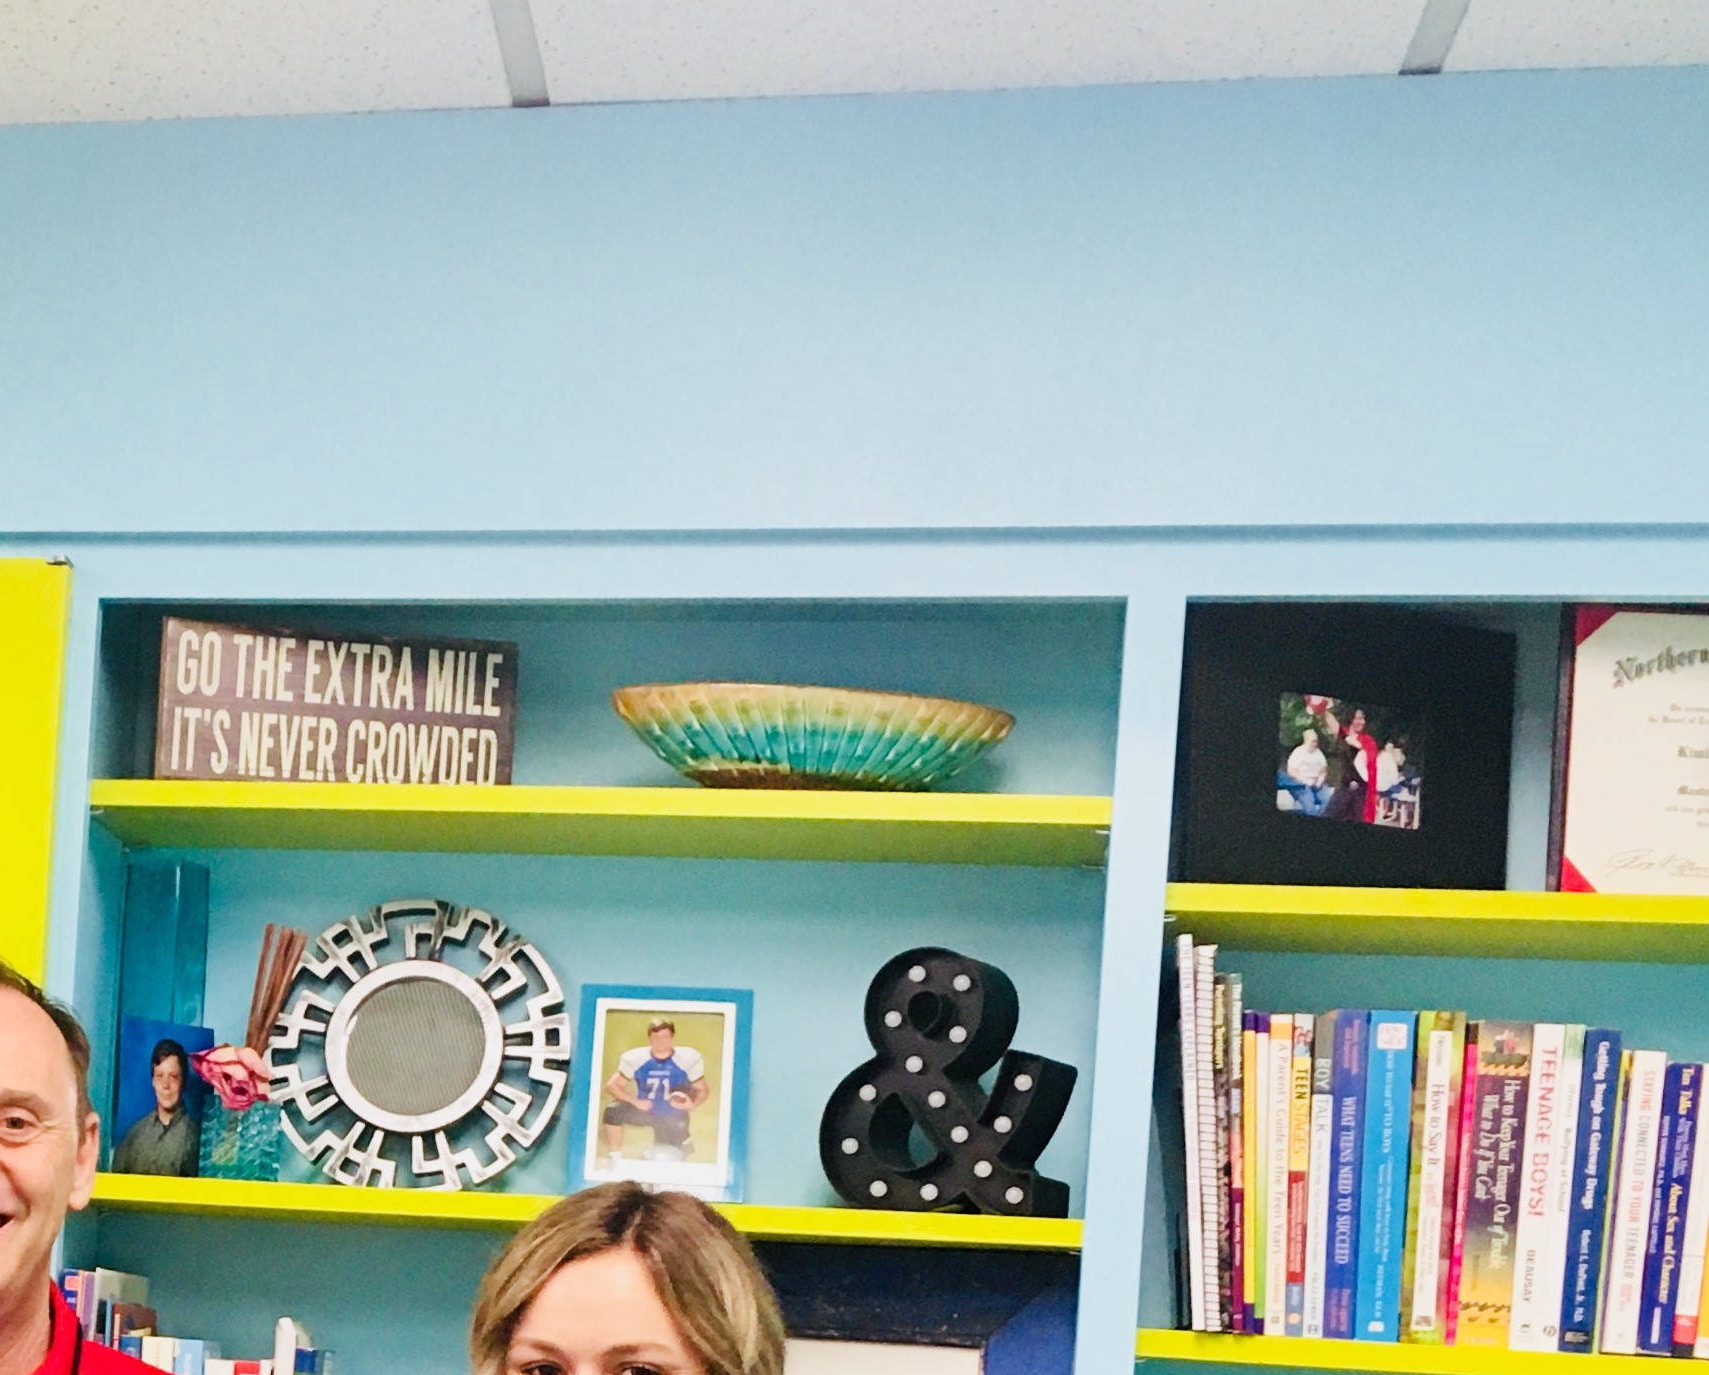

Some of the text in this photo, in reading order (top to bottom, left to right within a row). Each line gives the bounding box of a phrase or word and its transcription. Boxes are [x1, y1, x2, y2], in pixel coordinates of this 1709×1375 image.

[176, 630, 504, 717] GO THE EXTRA MILE
[170, 705, 499, 786] IT'S NEVER CROWDED
[1278, 1044, 1288, 1053] A
[645, 1077, 670, 1101] 71
[1313, 1058, 1332, 1091] BOY
[1640, 1070, 1656, 1112] STAYING
[1480, 1094, 1500, 1119] What
[1503, 1080, 1522, 1103] How
[1678, 1067, 1696, 1116] Ten Talks
[1276, 1108, 1288, 1143] Guide
[1292, 1068, 1309, 1155] TEEN STAGES
[1314, 1097, 1331, 1134] TALK
[1341, 1096, 1358, 1128] WHAT
[1424, 1083, 1446, 1166] How to Say It
[1480, 1120, 1493, 1131] to
[1501, 1104, 1514, 1116] to
[1581, 1041, 1611, 1210] Getting Tough on Gateway Drugs
[1338, 1129, 1356, 1162] TEENS
[1479, 1131, 1500, 1148] Do
[1497, 1117, 1519, 1141] Keep
[1527, 1047, 1559, 1218] TEENAGE BOYS!
[1634, 1115, 1651, 1176] CONNECTED
[1275, 1149, 1286, 1161] to
[1475, 1158, 1495, 1175] You
[1497, 1140, 1517, 1161] Your
[1274, 1166, 1287, 1186] the
[1337, 1164, 1354, 1195] NEED
[1491, 1163, 1516, 1202] Teenager
[1557, 1126, 1573, 1213] Bullying at School
[1631, 1180, 1645, 1192] TO
[1273, 1191, 1285, 1218] Teen
[1336, 1197, 1353, 1213] TO
[1493, 1203, 1512, 1223] Out
[1628, 1196, 1644, 1223] YOUR
[1272, 1223, 1284, 1256] Years
[1334, 1214, 1351, 1265] SUCCEED
[1621, 1227, 1640, 1279] TEENAGER
[1658, 1183, 1683, 1305] About Sex and Character
[1522, 1249, 1536, 1303] BEAUSAY
